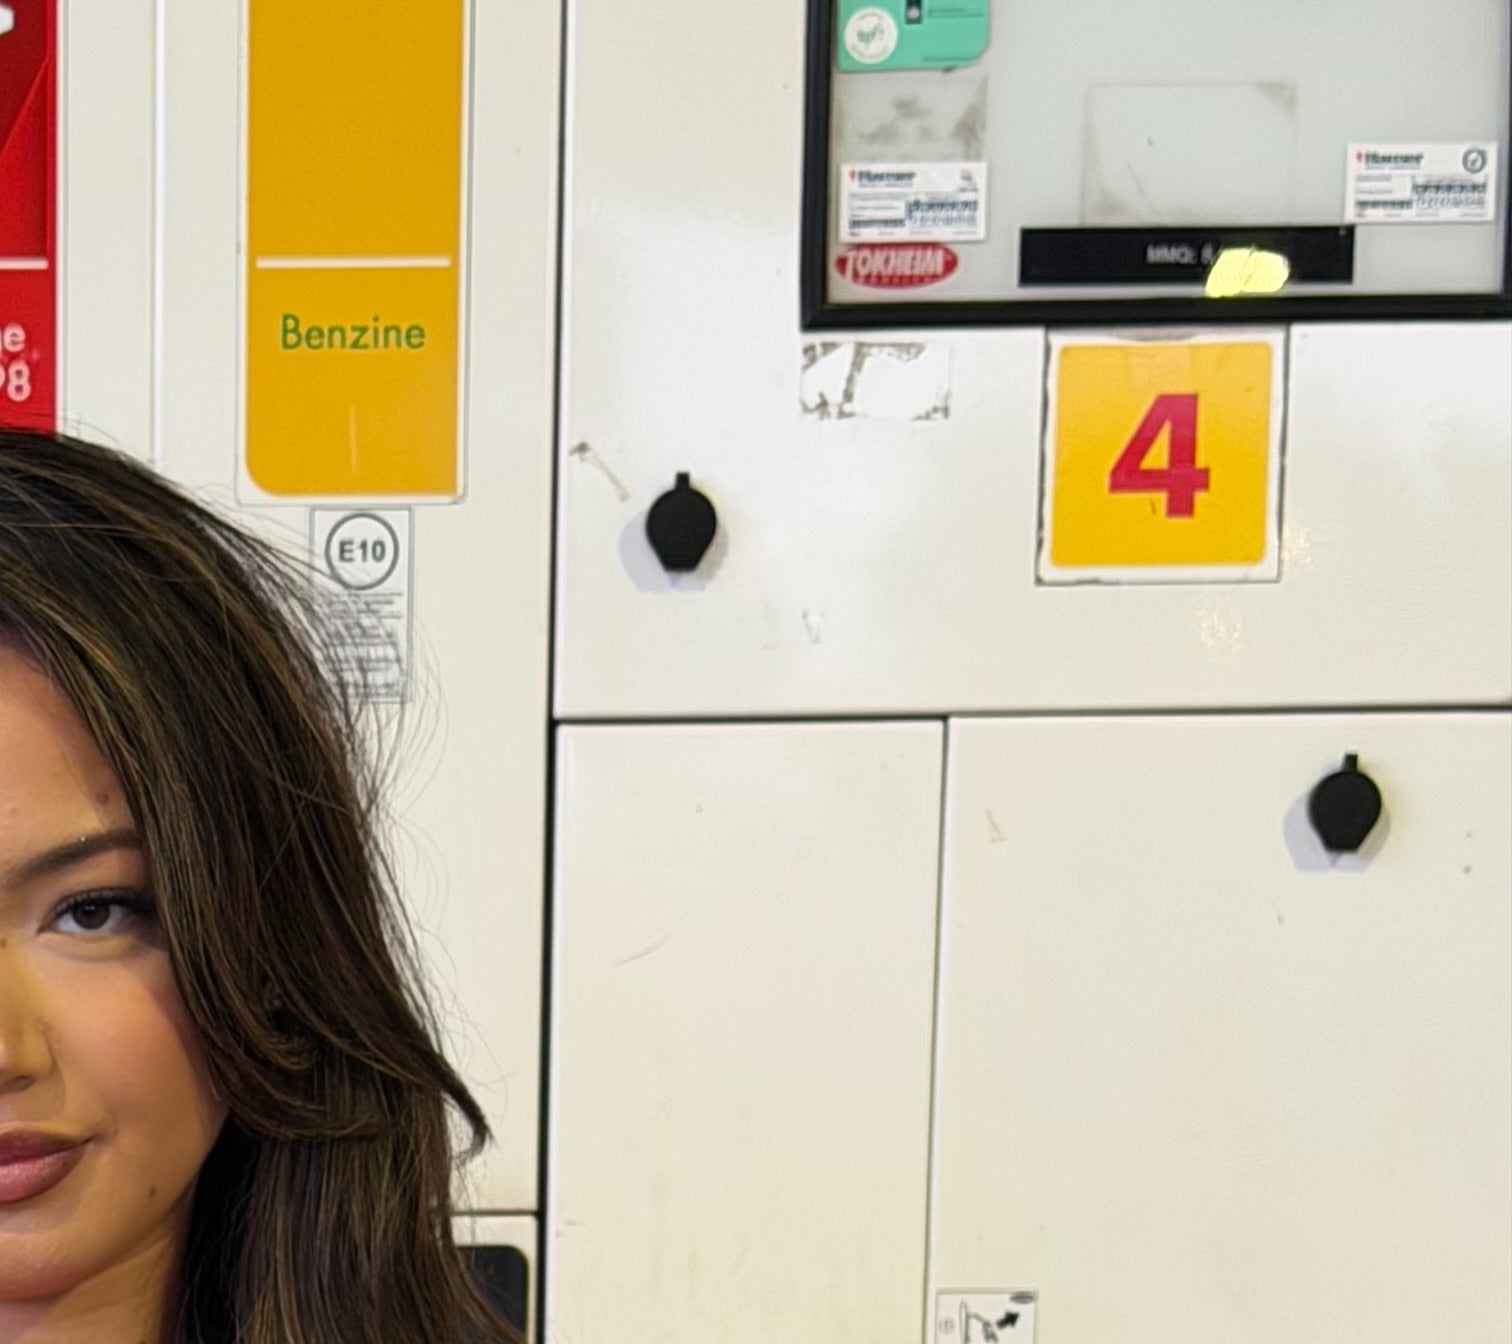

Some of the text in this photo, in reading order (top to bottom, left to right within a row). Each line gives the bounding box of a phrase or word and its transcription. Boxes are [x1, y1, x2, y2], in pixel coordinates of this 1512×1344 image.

[281, 313, 426, 350] Benzine
[1109, 393, 1210, 518] 4
[338, 539, 386, 563] E10
